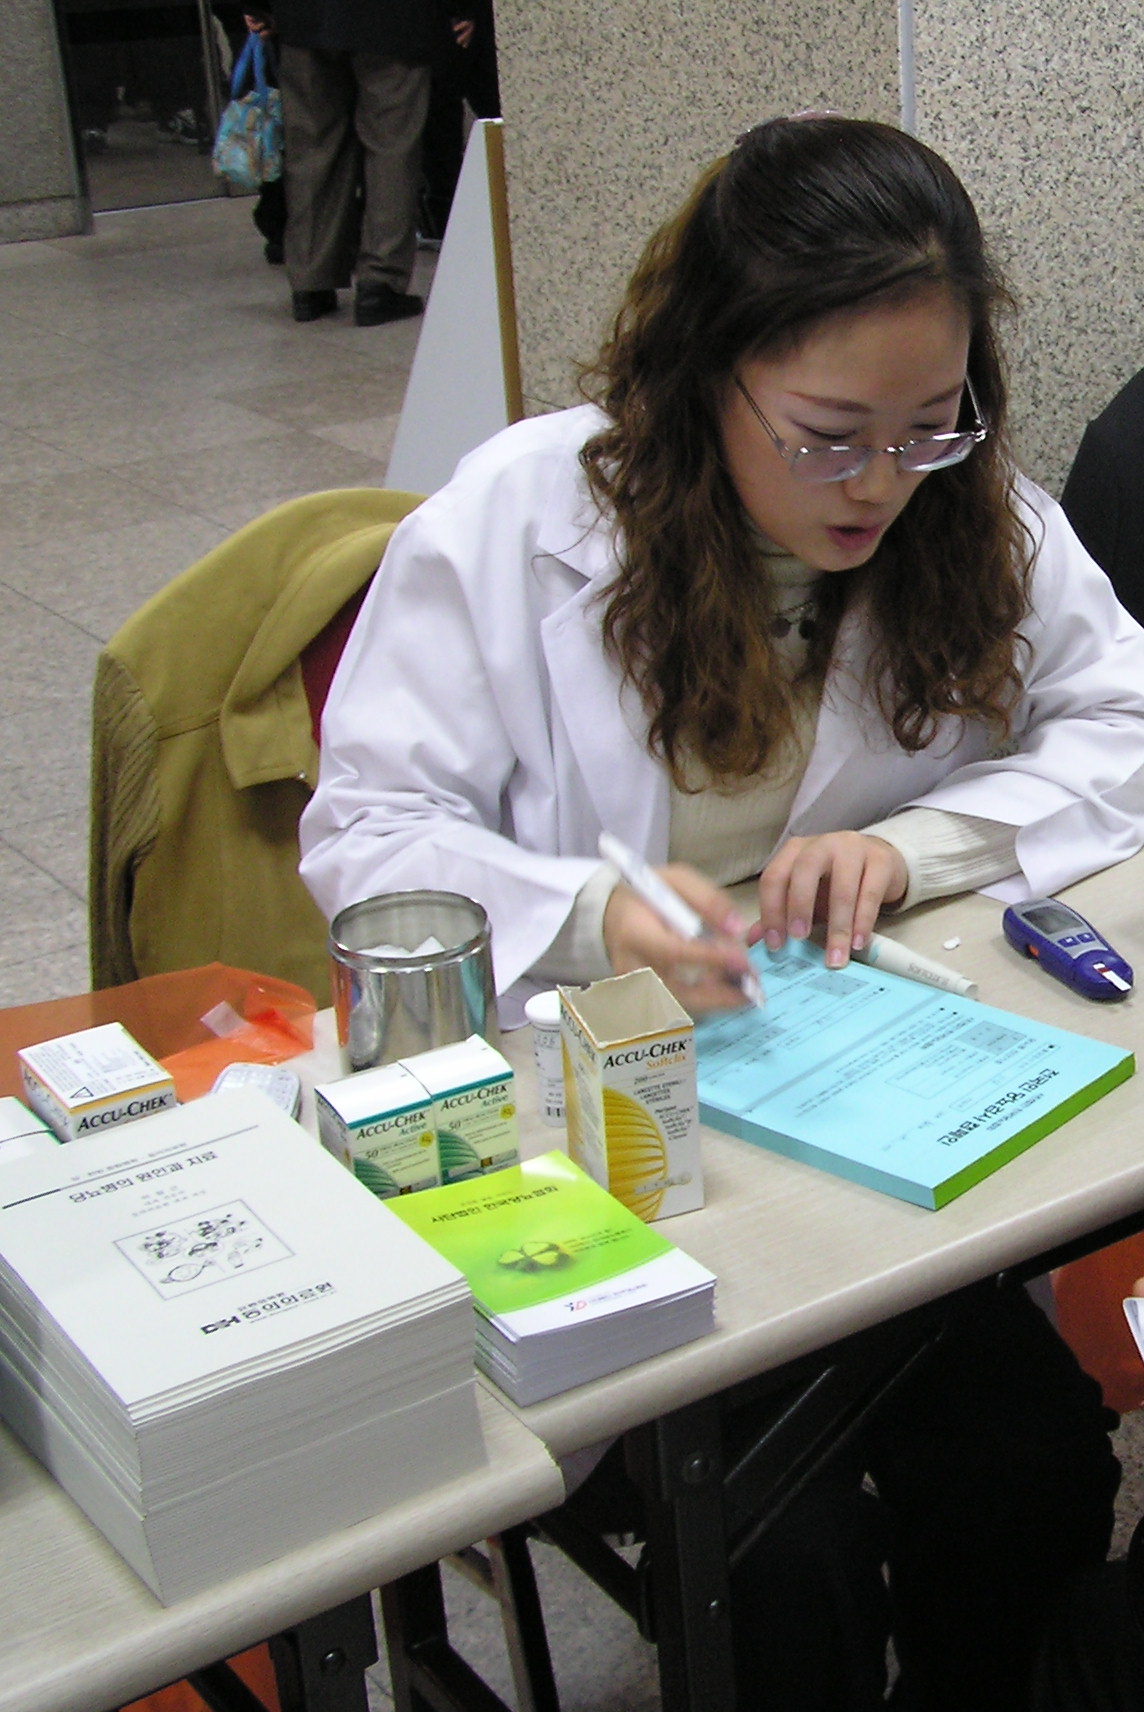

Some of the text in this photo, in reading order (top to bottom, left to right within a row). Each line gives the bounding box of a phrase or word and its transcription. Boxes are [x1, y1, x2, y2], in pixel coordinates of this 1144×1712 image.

[603, 1040, 687, 1069] ACCU-CHEK
[1018, 1068, 1059, 1093] 전국민
[440, 1084, 507, 1112] ACCU-CHEK
[973, 1092, 1026, 1122] 당뇨검사
[77, 1095, 167, 1132] ACCU-CHEK
[356, 1112, 426, 1140] ACCU-CHEK
[937, 1121, 980, 1146] 캠페인
[68, 1178, 134, 1204] 당뇨병의
